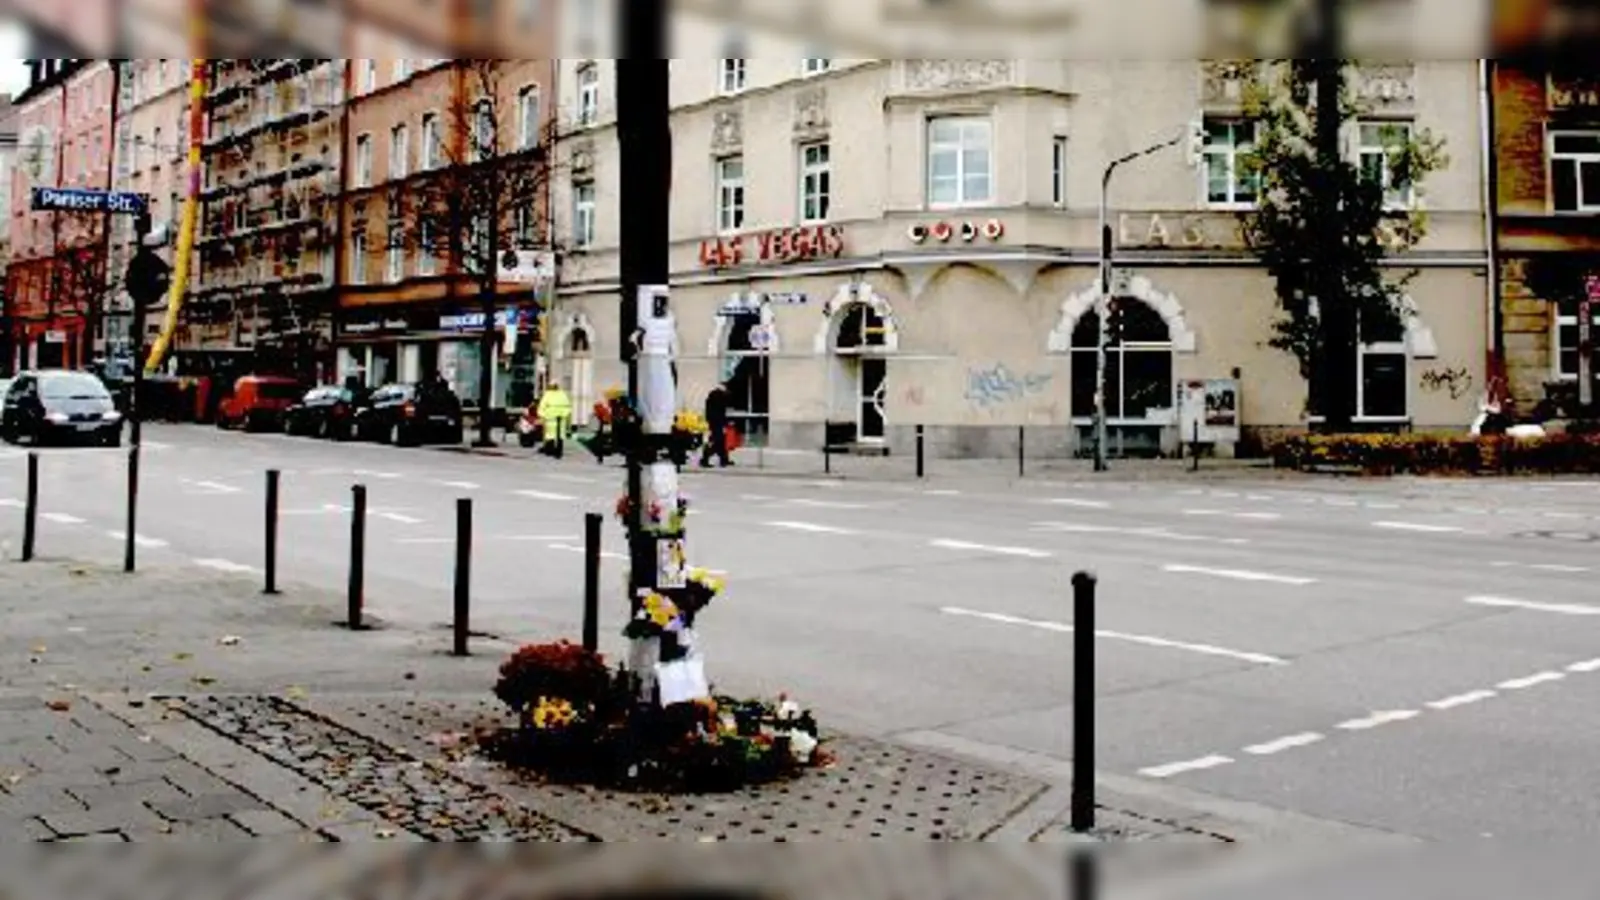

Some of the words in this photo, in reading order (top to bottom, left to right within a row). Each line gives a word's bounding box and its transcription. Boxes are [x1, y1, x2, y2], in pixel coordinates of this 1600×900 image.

[699, 235, 743, 266] LAS
[756, 225, 844, 260] VEGAS
[1119, 213, 1204, 245] LAS
